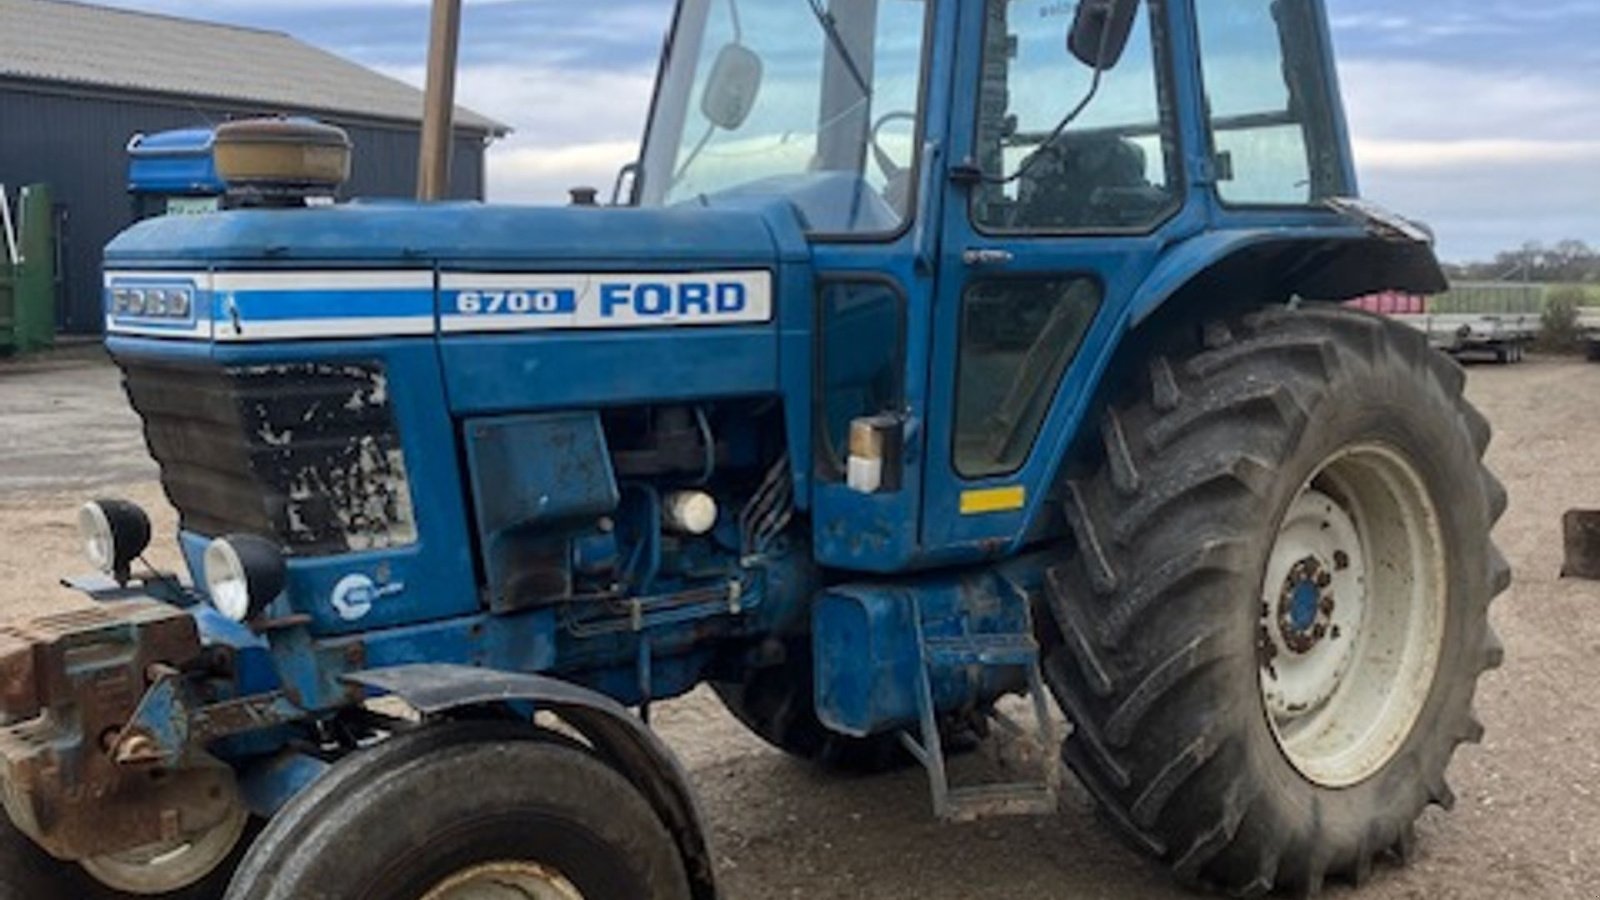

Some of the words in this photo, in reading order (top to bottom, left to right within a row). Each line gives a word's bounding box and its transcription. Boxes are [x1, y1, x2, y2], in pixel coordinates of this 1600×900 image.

[112, 287, 190, 317] FORD
[456, 291, 559, 314] 6700
[600, 281, 746, 317] FORD
